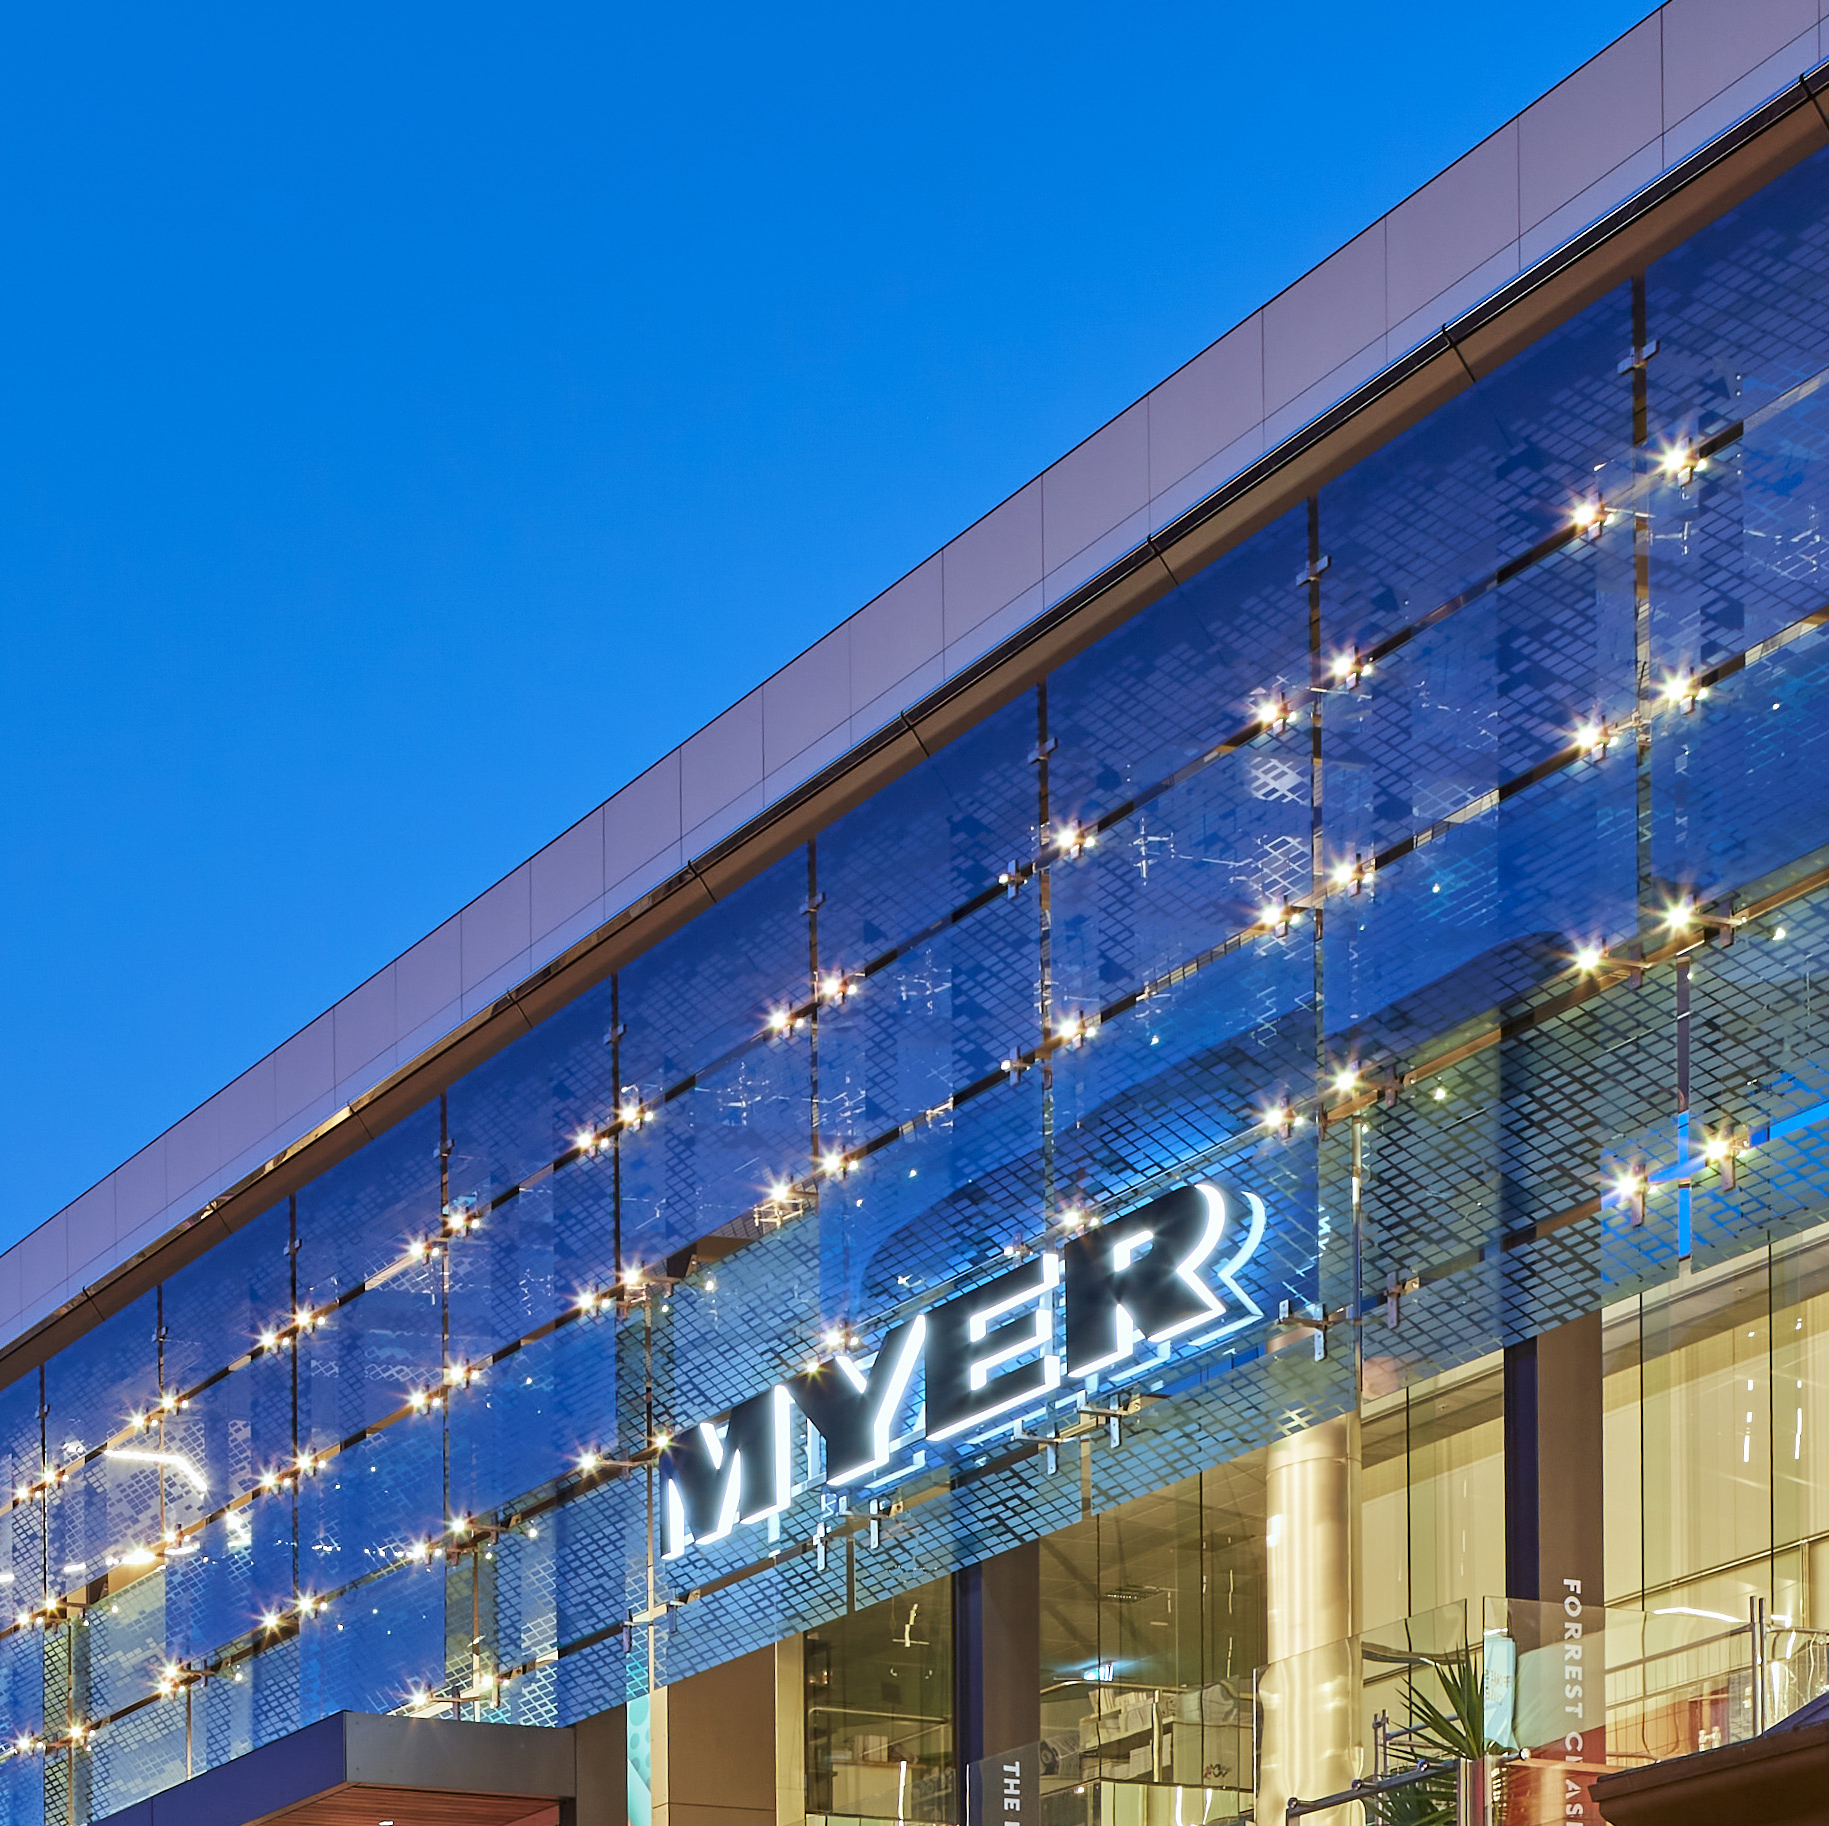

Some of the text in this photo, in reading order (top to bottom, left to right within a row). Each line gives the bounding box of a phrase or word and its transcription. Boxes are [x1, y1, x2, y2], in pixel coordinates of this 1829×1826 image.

[660, 1184, 1229, 1560] MYER
[1563, 1578, 1583, 1718] FORREST
[1003, 1761, 1021, 1812] THE
